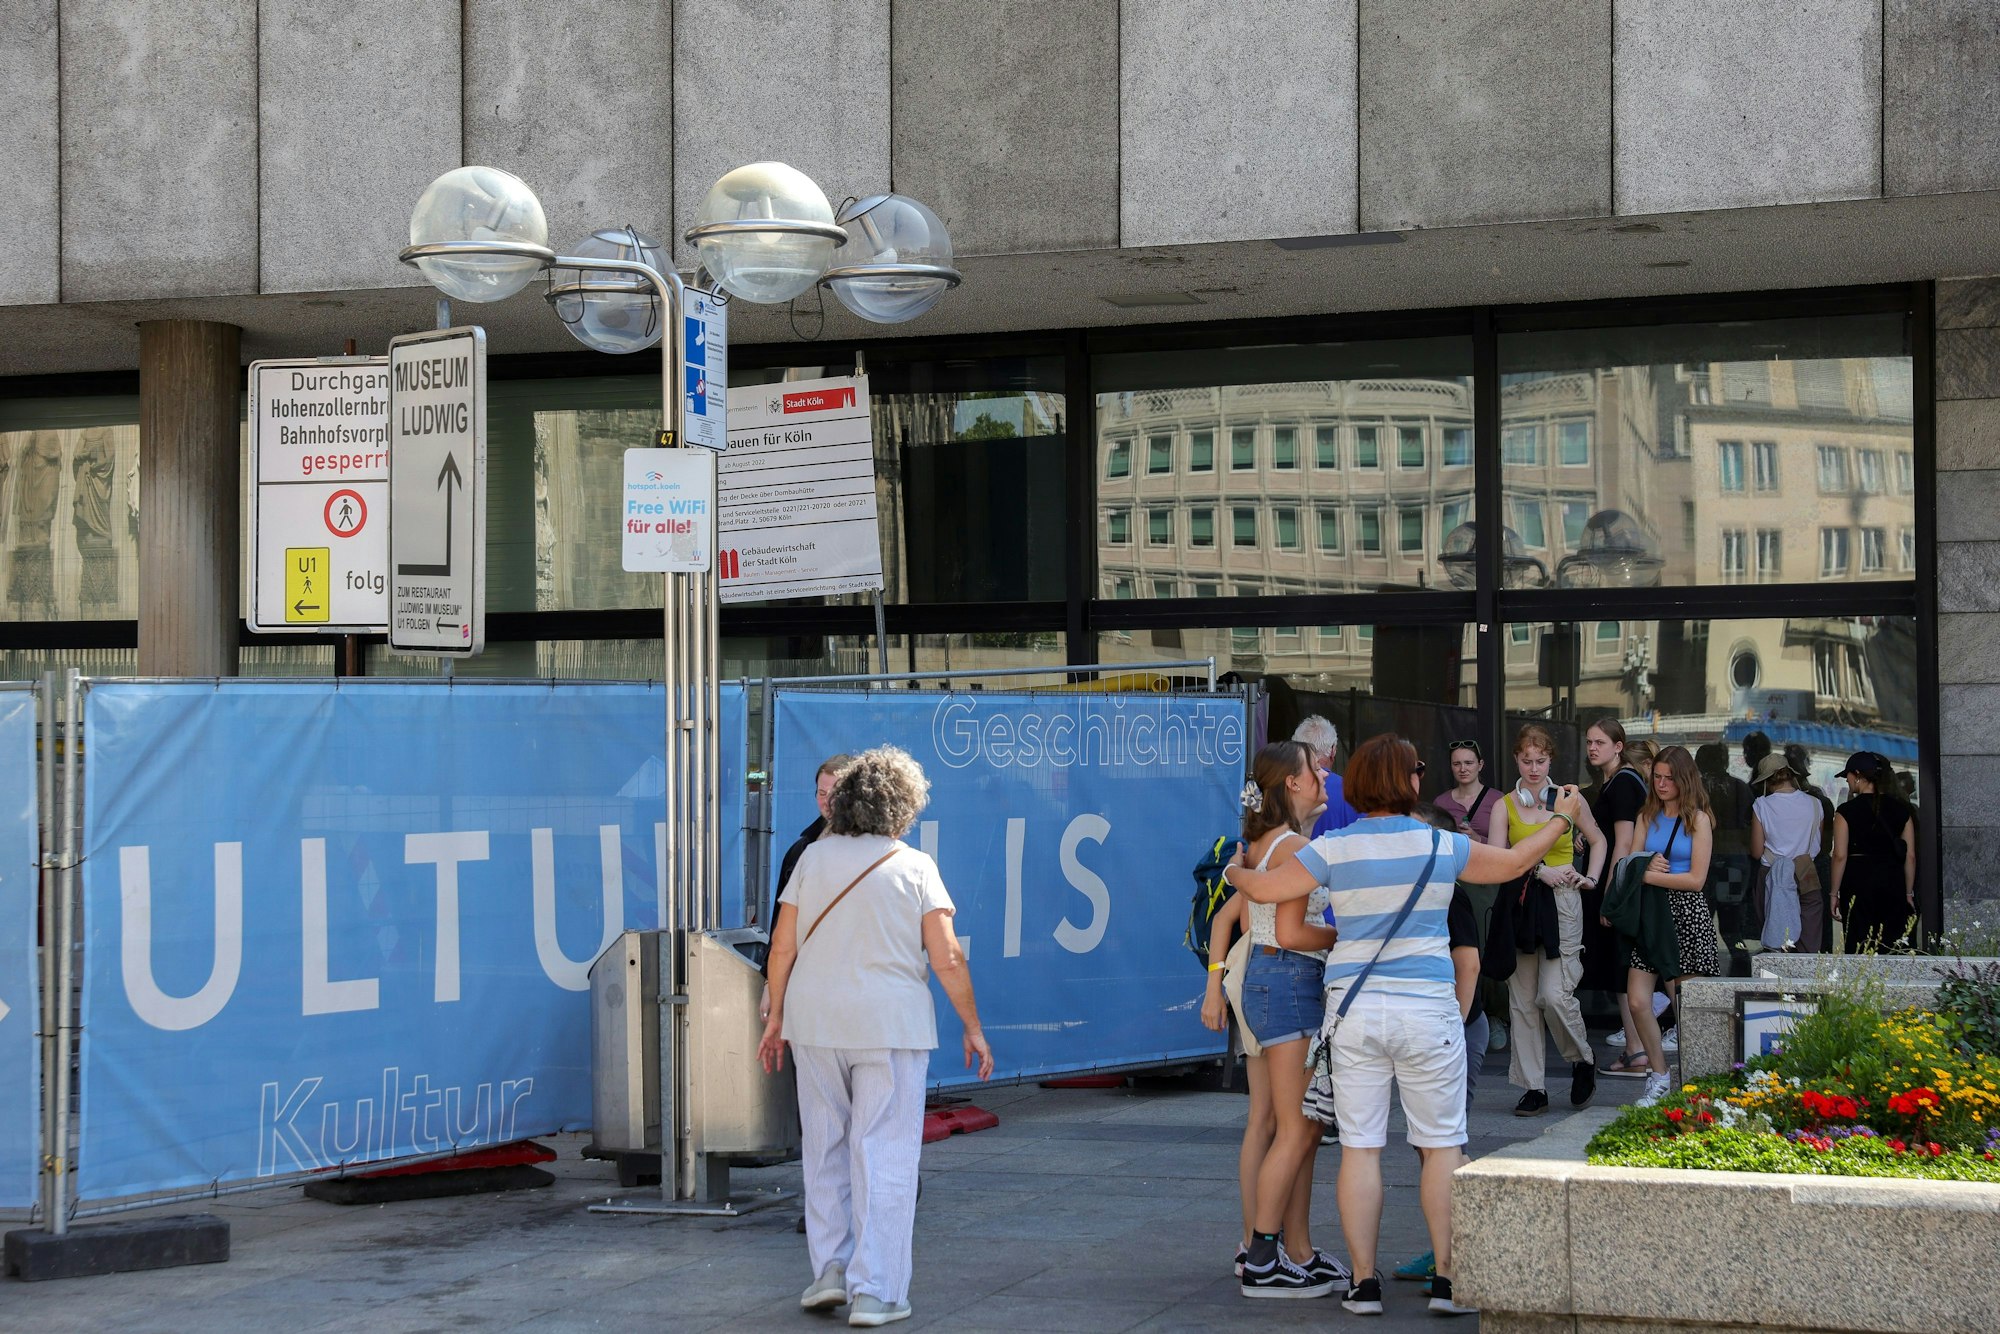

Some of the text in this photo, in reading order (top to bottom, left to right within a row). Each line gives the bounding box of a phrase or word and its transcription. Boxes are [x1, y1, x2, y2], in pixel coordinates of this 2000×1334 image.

[395, 356, 468, 392] MUSEUM
[291, 371, 388, 394] Durchgan
[271, 396, 388, 418] Hohenzollernbr
[786, 396, 824, 409] Stadt Köln
[402, 402, 468, 436] LUDWIG
[764, 432, 781, 446] für
[785, 430, 812, 443] Köln
[724, 461, 732, 469] ab
[732, 461, 750, 469] August
[740, 492, 758, 500] Decke
[759, 490, 773, 498] über
[774, 487, 815, 496] Dombauhütte
[628, 500, 706, 514] Free WiFi
[627, 519, 691, 534] für alle!
[741, 541, 816, 556] Gebäudewirtschaft
[298, 557, 316, 573] U1
[742, 555, 797, 568] der Stadt Köln
[346, 570, 388, 594] folg
[397, 586, 451, 599] ZUM RESTAURANT
[425, 604, 432, 614] IM
[398, 618, 430, 630] U1 FOLGEN
[932, 694, 1243, 768] Geschichte
[257, 1066, 534, 1178] Kultur
